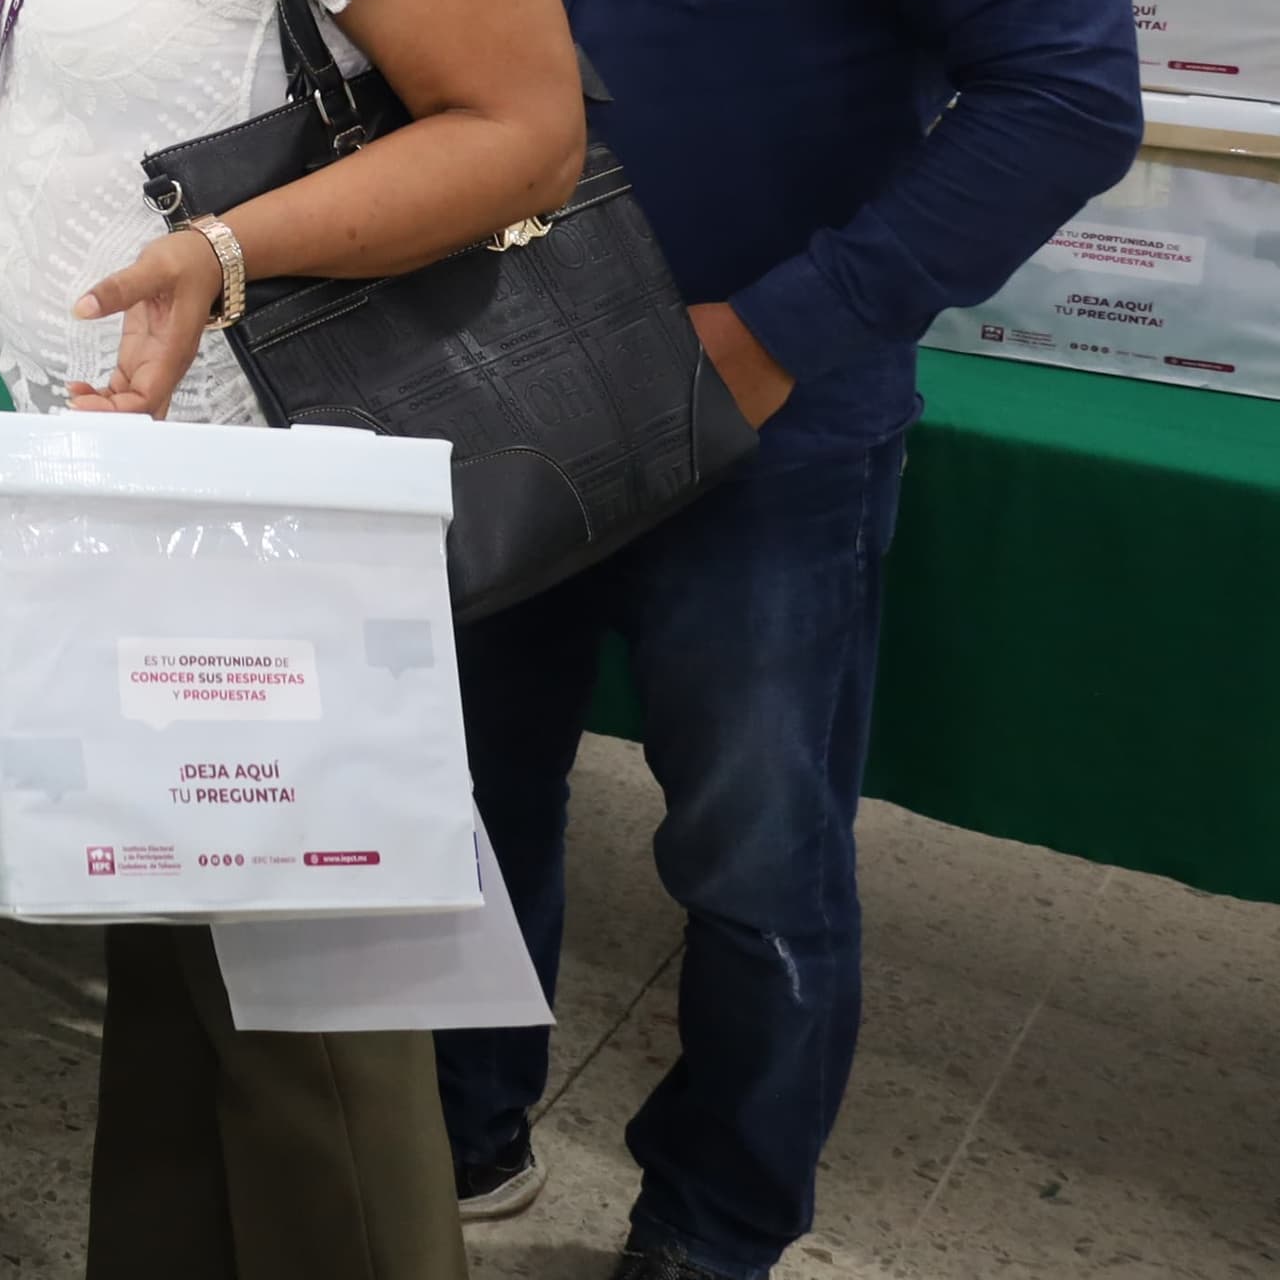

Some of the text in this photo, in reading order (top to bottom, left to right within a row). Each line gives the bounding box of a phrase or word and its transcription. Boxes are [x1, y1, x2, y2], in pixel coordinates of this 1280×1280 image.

[1081, 232, 1164, 249] OPORTUNIDAD
[1166, 243, 1180, 251] DE
[1081, 252, 1155, 268] PROPUESTAS
[1096, 244, 1118, 253] SUS
[1120, 247, 1192, 262] RESPUESTAS
[1067, 294, 1153, 312] ¡DEJA AQUÍ
[1054, 305, 1164, 327] TU PREGUNTA!
[144, 656, 289, 668] ES TU OPORTUNIDAD DE
[130, 672, 305, 685] CONOCER SUS RESPUESTAS
[172, 690, 266, 701] Y PROPUESTAS
[180, 760, 280, 782] ¡DEJA AQUÍ
[170, 788, 295, 804] TU PREGUNTA!
